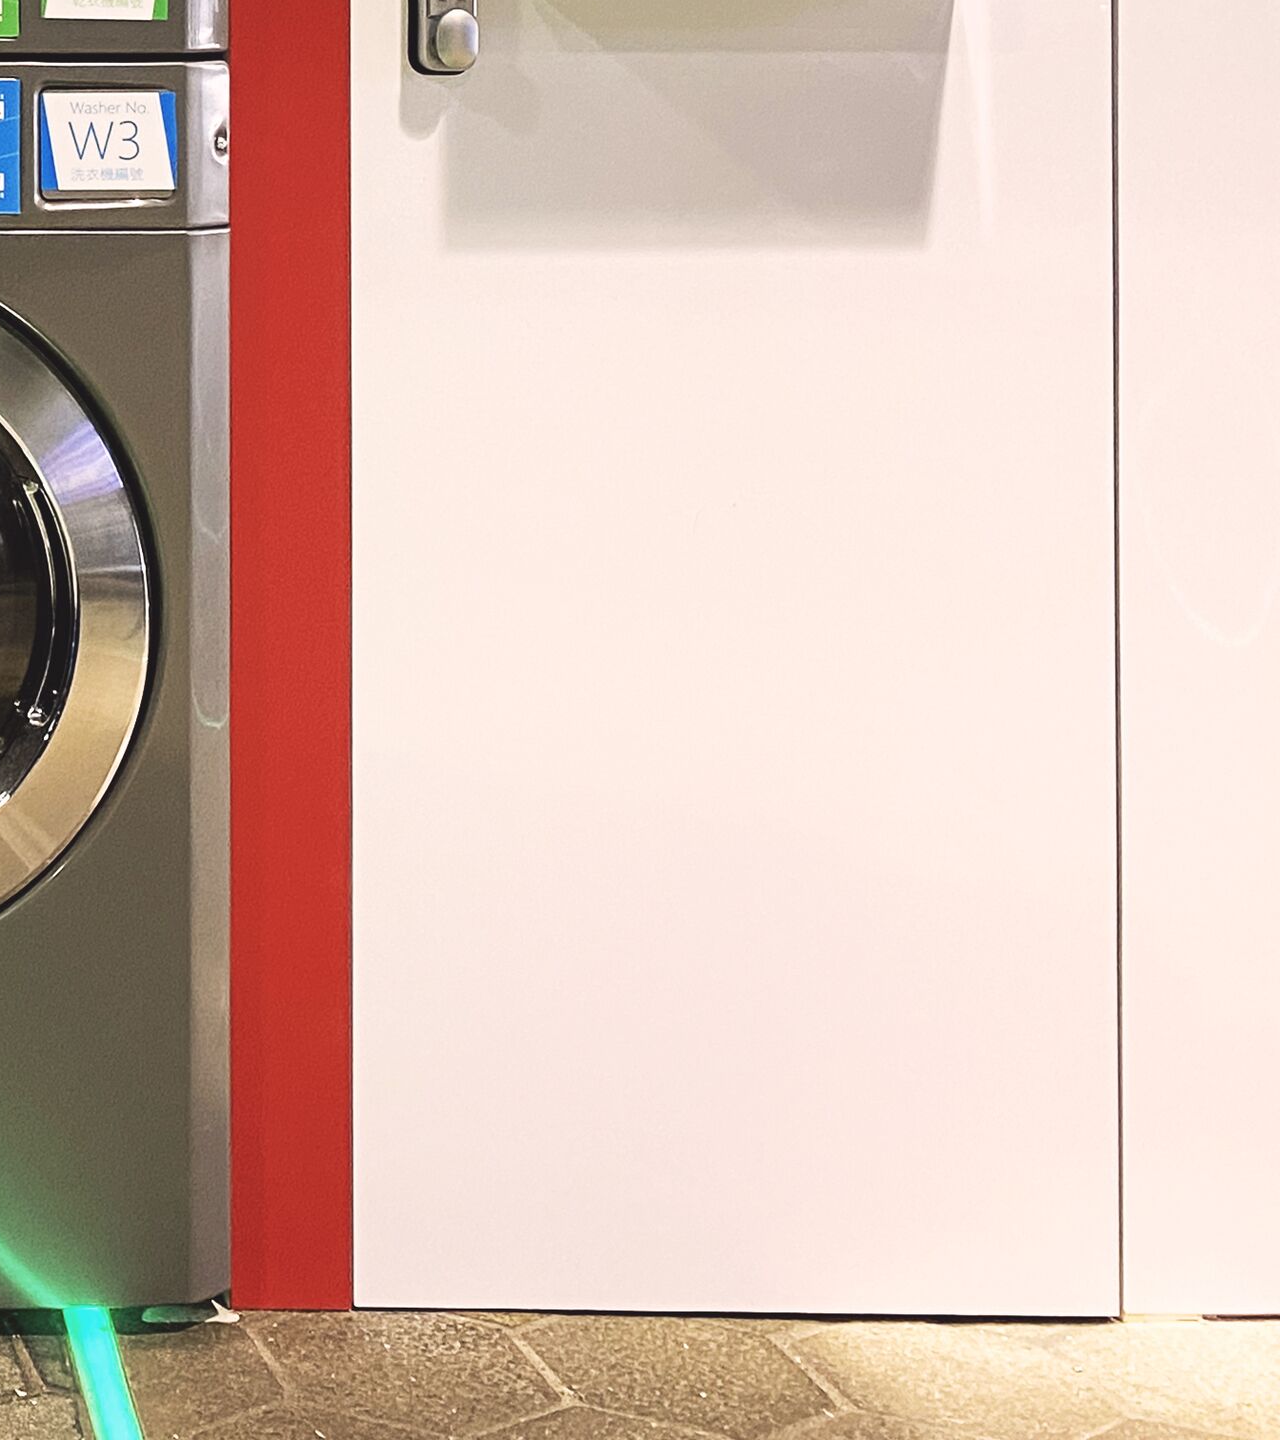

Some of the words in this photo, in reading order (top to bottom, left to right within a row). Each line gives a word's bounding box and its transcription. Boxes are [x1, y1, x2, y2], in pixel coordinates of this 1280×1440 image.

[70, 102, 121, 115] Washer
[125, 103, 149, 114] No.
[68, 121, 140, 161] W3
